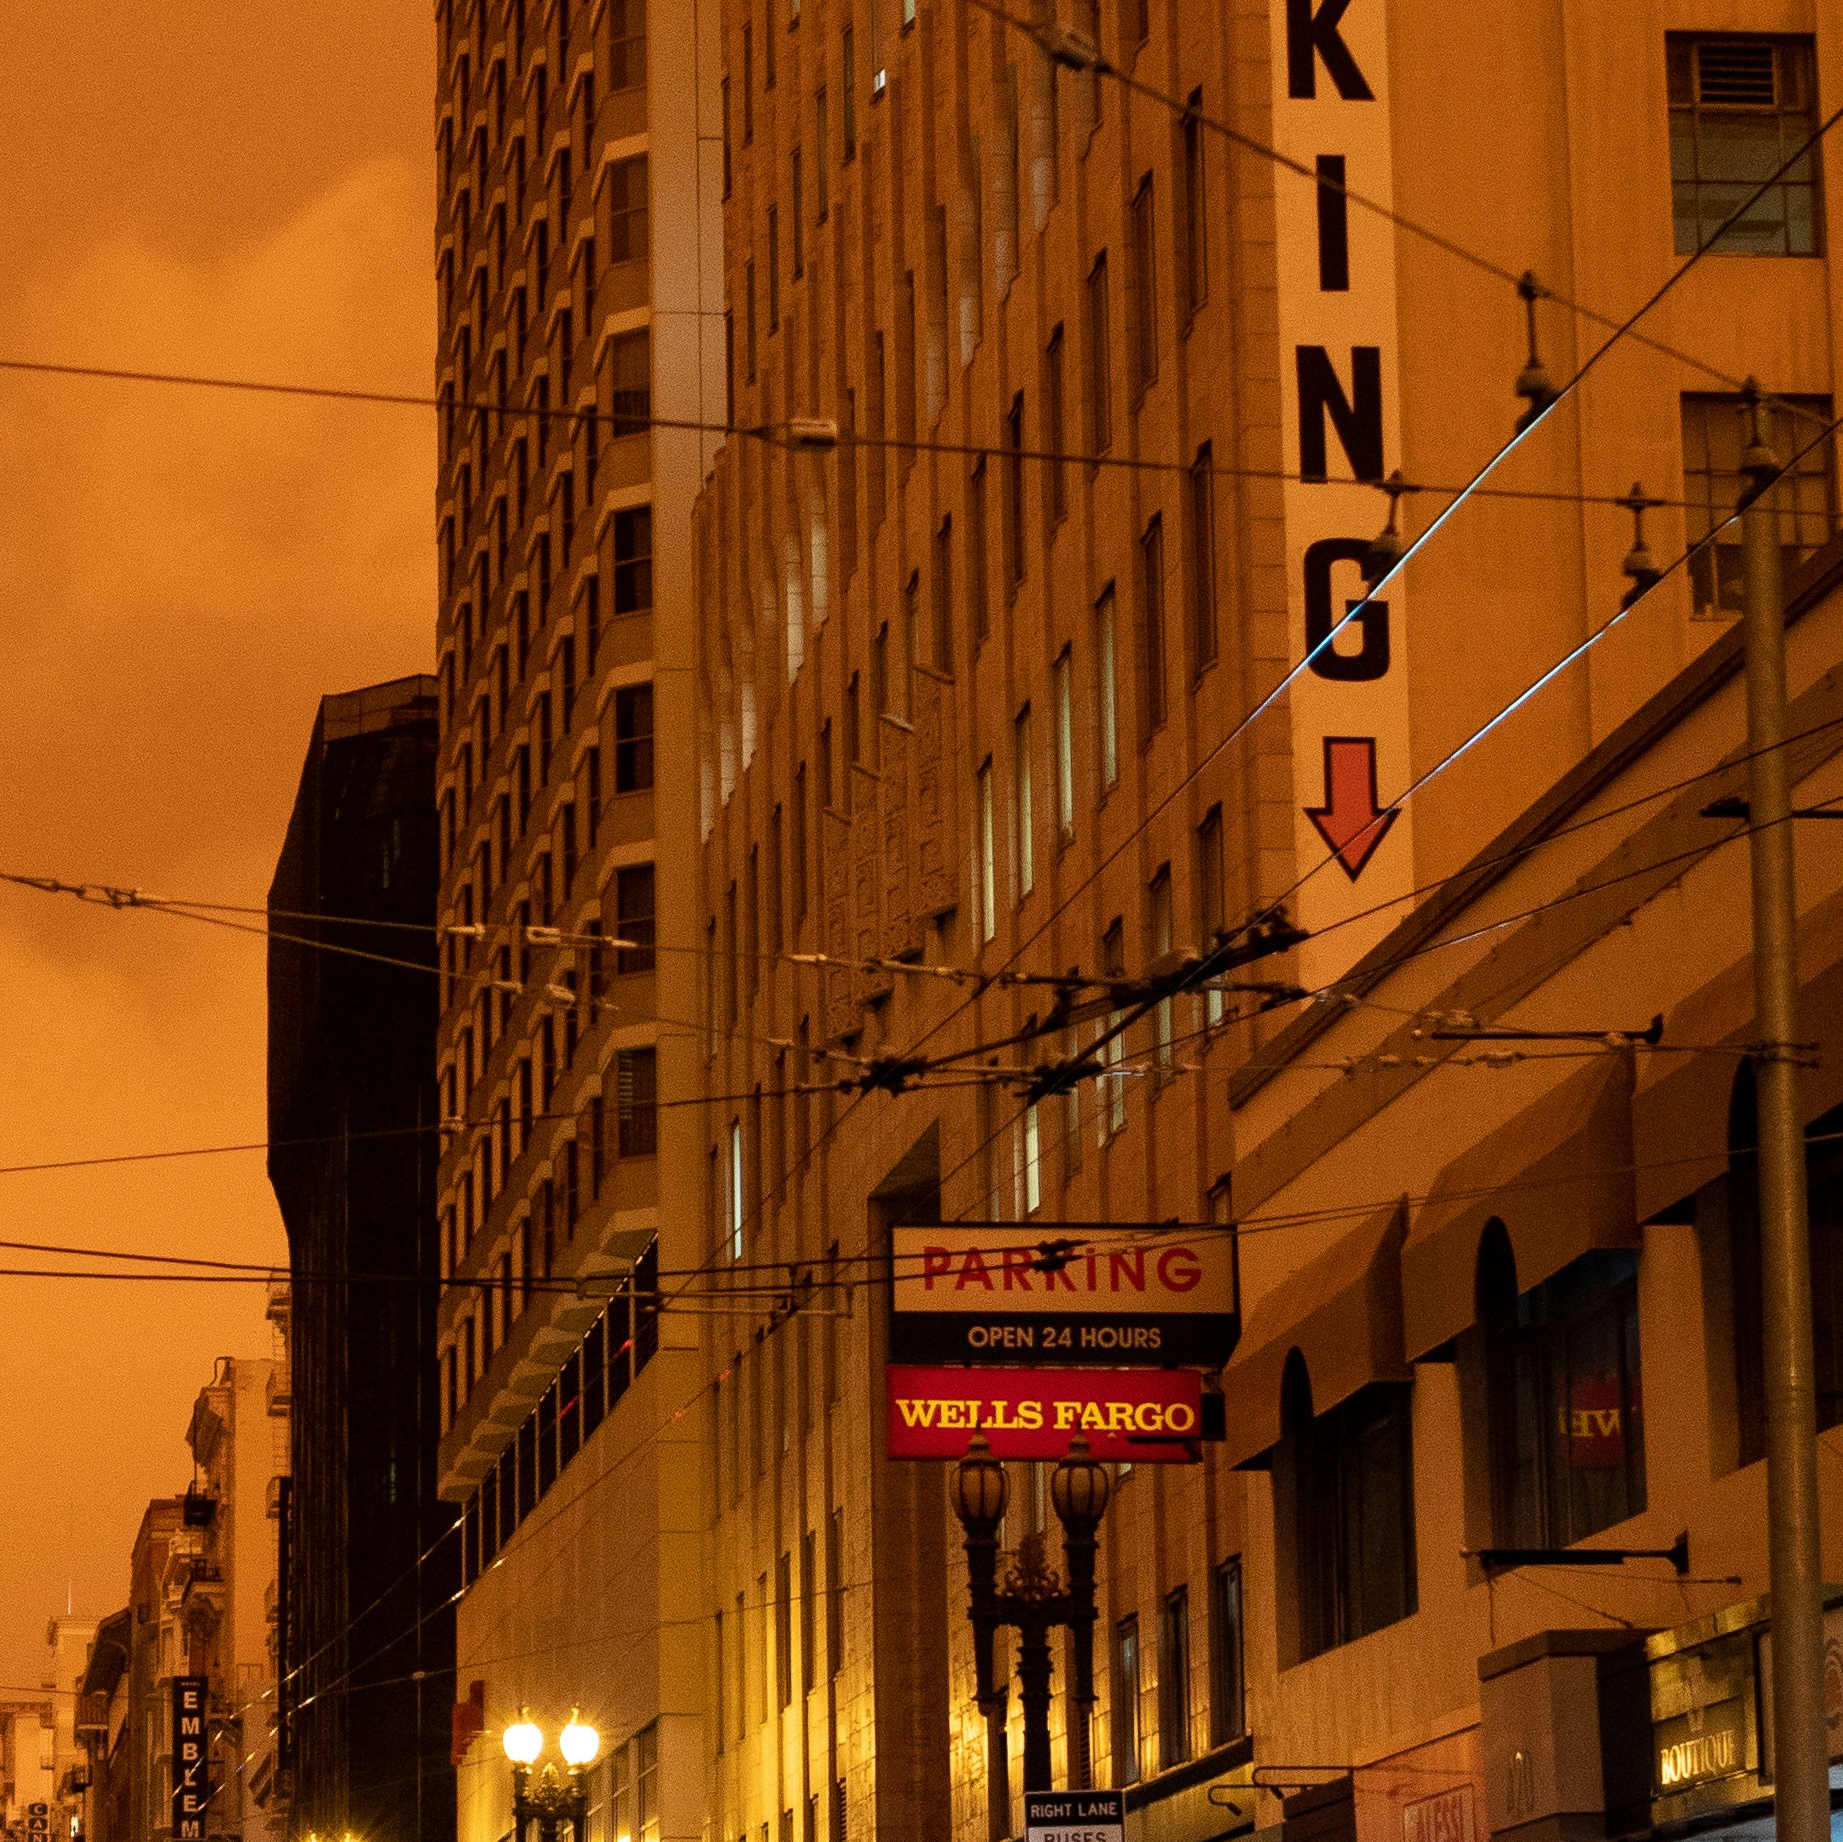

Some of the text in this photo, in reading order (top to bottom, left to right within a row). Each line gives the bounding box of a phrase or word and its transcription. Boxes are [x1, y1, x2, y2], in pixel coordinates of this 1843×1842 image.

[922, 1245, 1203, 1293] PARKING
[967, 1325, 1162, 1349] OPEN 24 HOURS
[895, 1398, 1195, 1432] WELLS FARGO
[181, 1690, 201, 1839] EMBLEM
[1660, 1728, 1735, 1786] BOUTIQUE
[1030, 1801, 1118, 1818] RIGHT LANE
